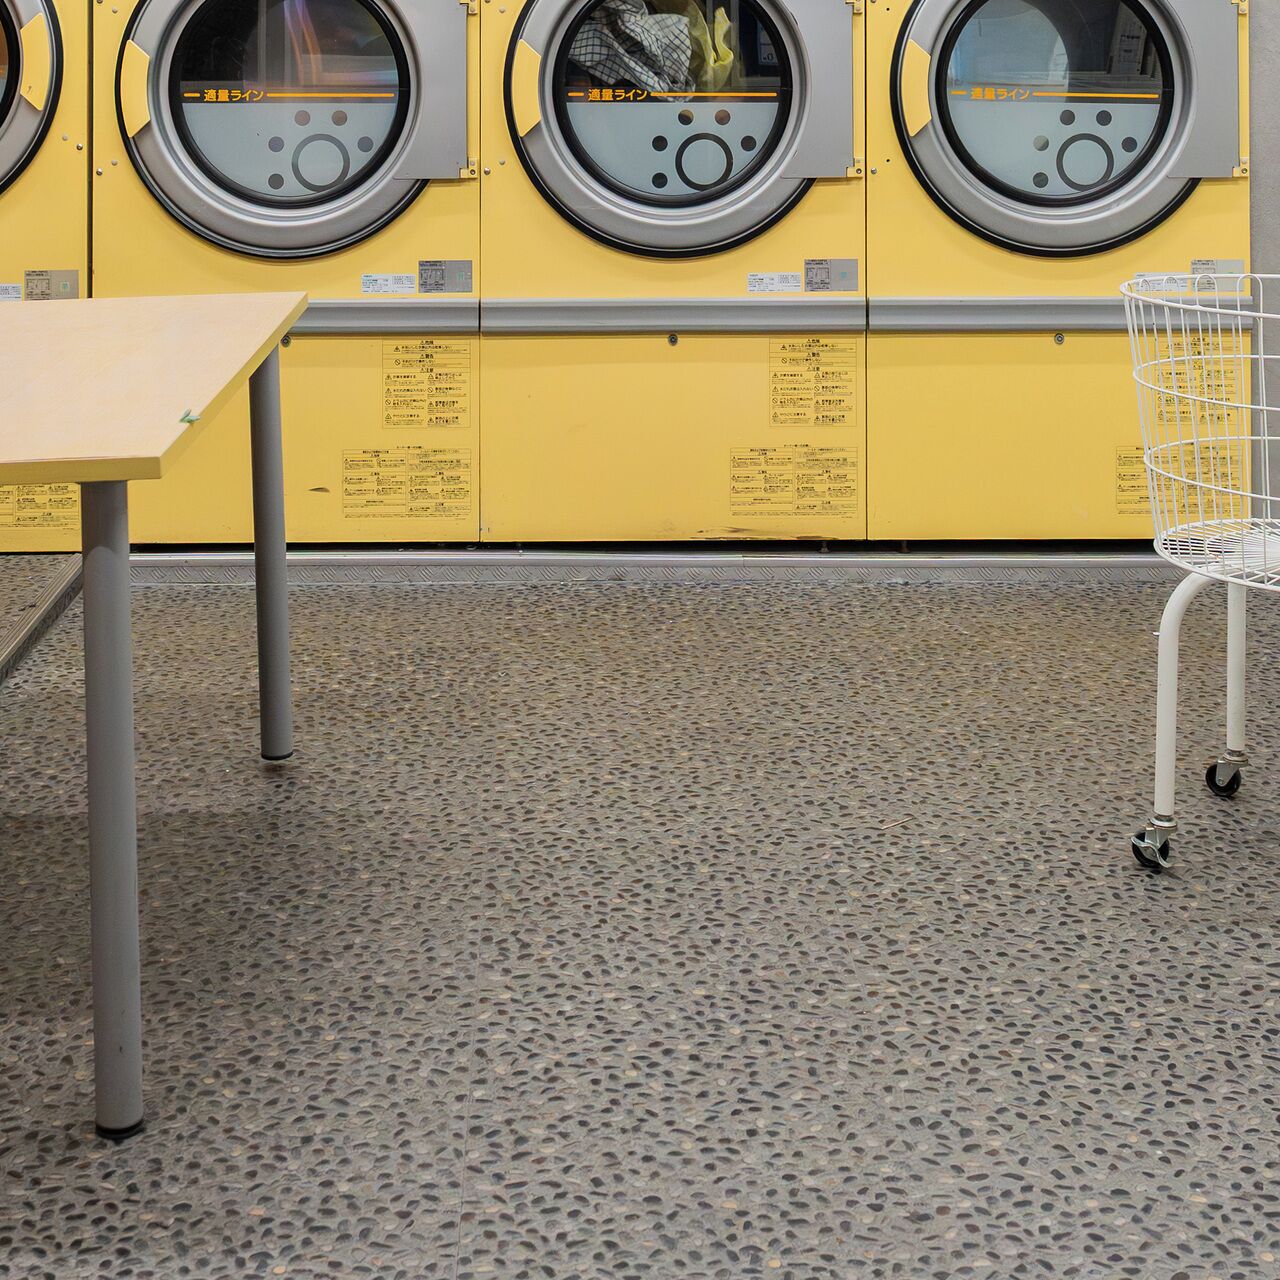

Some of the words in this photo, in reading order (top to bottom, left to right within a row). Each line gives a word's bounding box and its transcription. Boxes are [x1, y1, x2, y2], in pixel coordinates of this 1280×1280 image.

[203, 89, 264, 102] 適量ライン
[588, 89, 648, 102] 適量ライン
[970, 87, 1029, 101] 適量ライン
